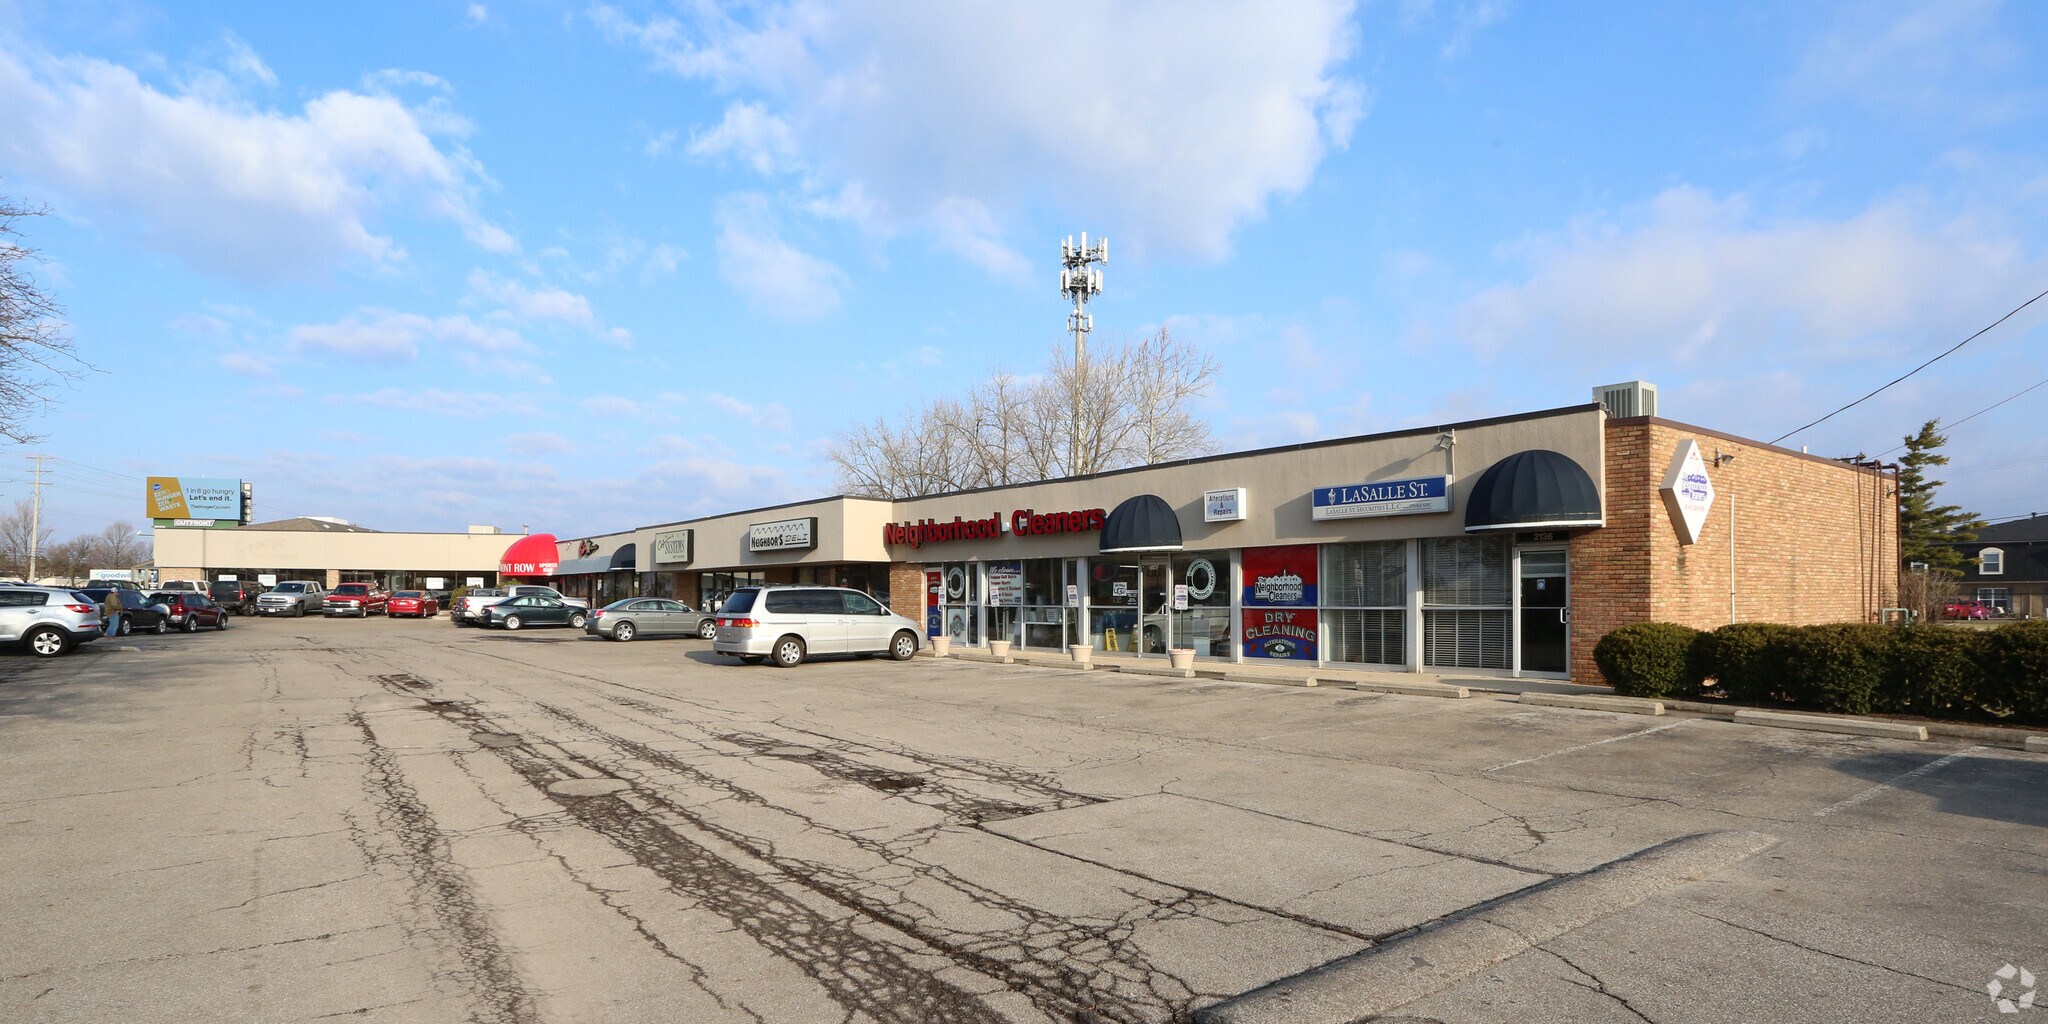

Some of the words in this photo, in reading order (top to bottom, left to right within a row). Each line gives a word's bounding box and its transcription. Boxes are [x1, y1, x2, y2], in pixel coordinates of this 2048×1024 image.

[156, 491, 182, 502] HUNGER
[1208, 494, 1235, 502] Alterations
[159, 501, 182, 512] WASTE
[1213, 507, 1232, 516] Repairs
[885, 511, 1001, 549] Neighborhood
[1011, 507, 1106, 538] Cleaners
[784, 533, 808, 543] DELI
[1534, 532, 1554, 541] 2136
[513, 563, 535, 573] ROW
[1255, 582, 1303, 594] Neighborhood
[1268, 591, 1297, 602] Cleaners
[1264, 611, 1296, 623] DRY
[1245, 624, 1317, 642] CLEANING
[1263, 638, 1296, 649] ALTERATIONS
